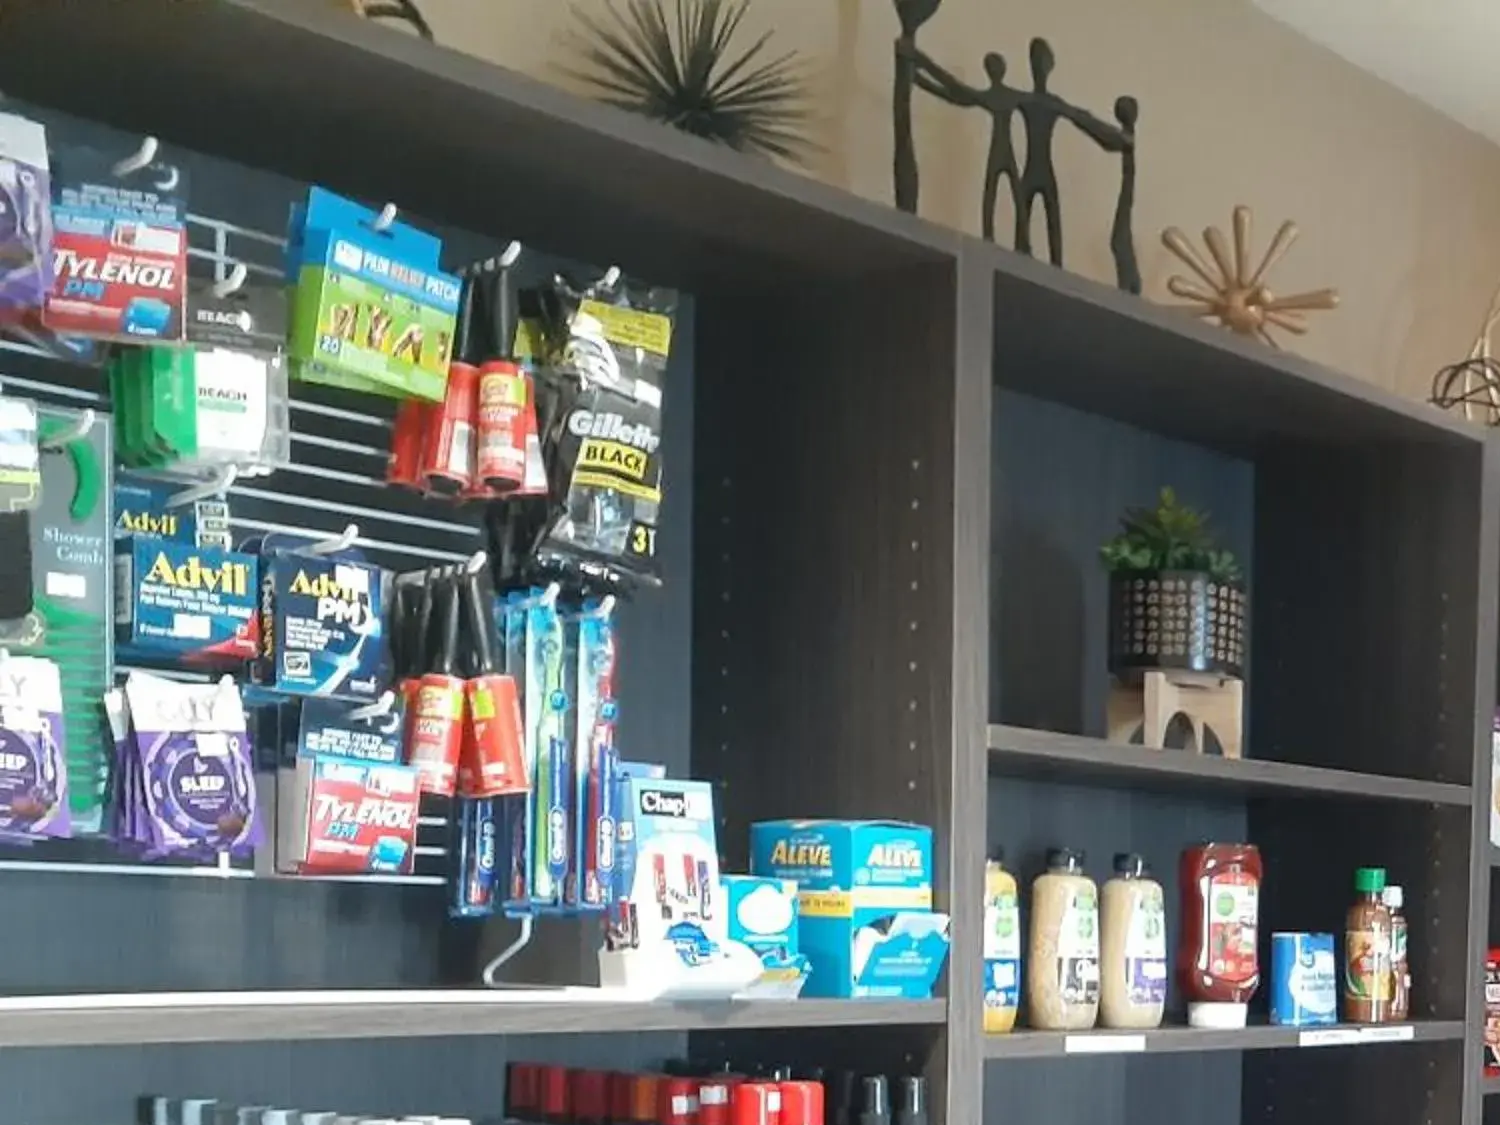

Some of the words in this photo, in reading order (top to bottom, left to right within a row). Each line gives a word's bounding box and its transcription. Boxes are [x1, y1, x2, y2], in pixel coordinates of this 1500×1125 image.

[52, 248, 176, 290] TYLENOL
[568, 408, 660, 454] Gillette
[585, 444, 643, 474] BLACK
[114, 508, 178, 536] Advil
[143, 550, 249, 596] Advil
[317, 597, 362, 626] PM
[314, 793, 414, 829] TYLENOL
[641, 789, 688, 818] Chap
[770, 839, 833, 867] ALEVE
